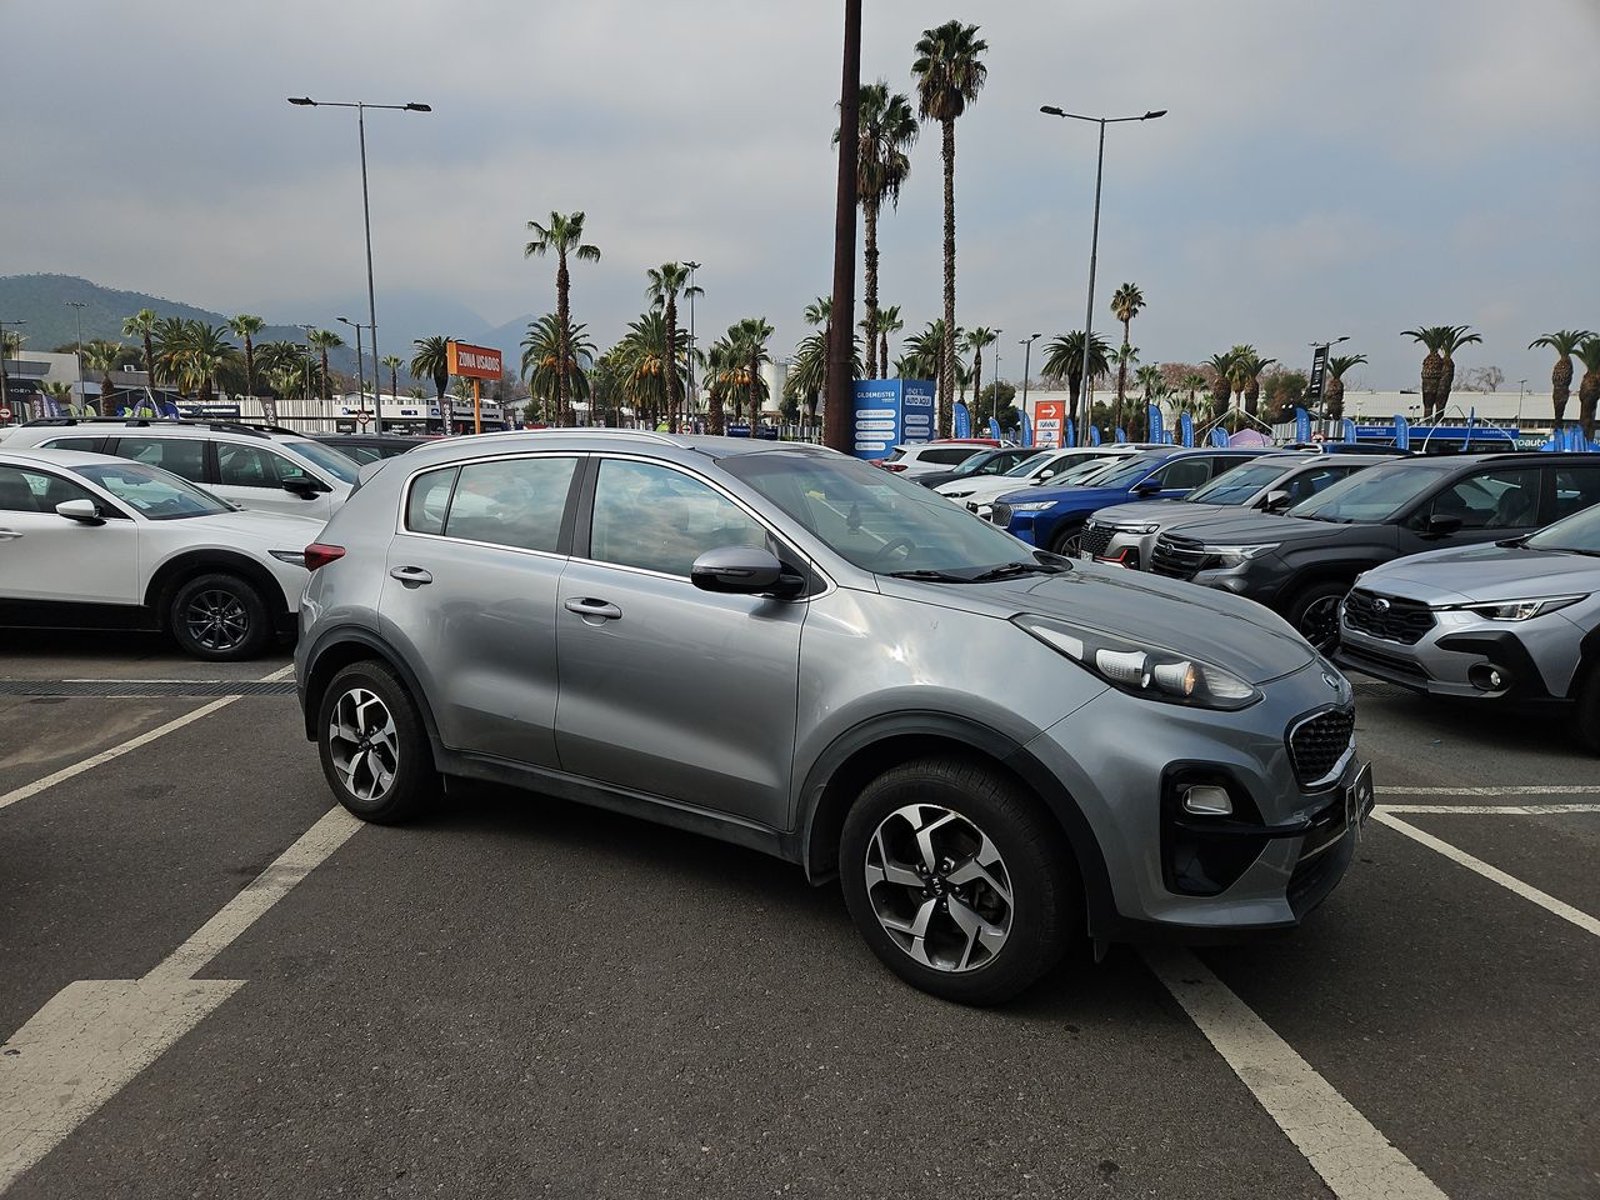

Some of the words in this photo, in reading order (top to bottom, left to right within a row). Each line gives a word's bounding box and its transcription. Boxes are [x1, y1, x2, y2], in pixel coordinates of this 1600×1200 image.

[458, 351, 476, 368] ZONA
[476, 355, 500, 372] USADOS
[856, 391, 896, 399] GILDEMEISTER
[932, 877, 943, 895] KIA
